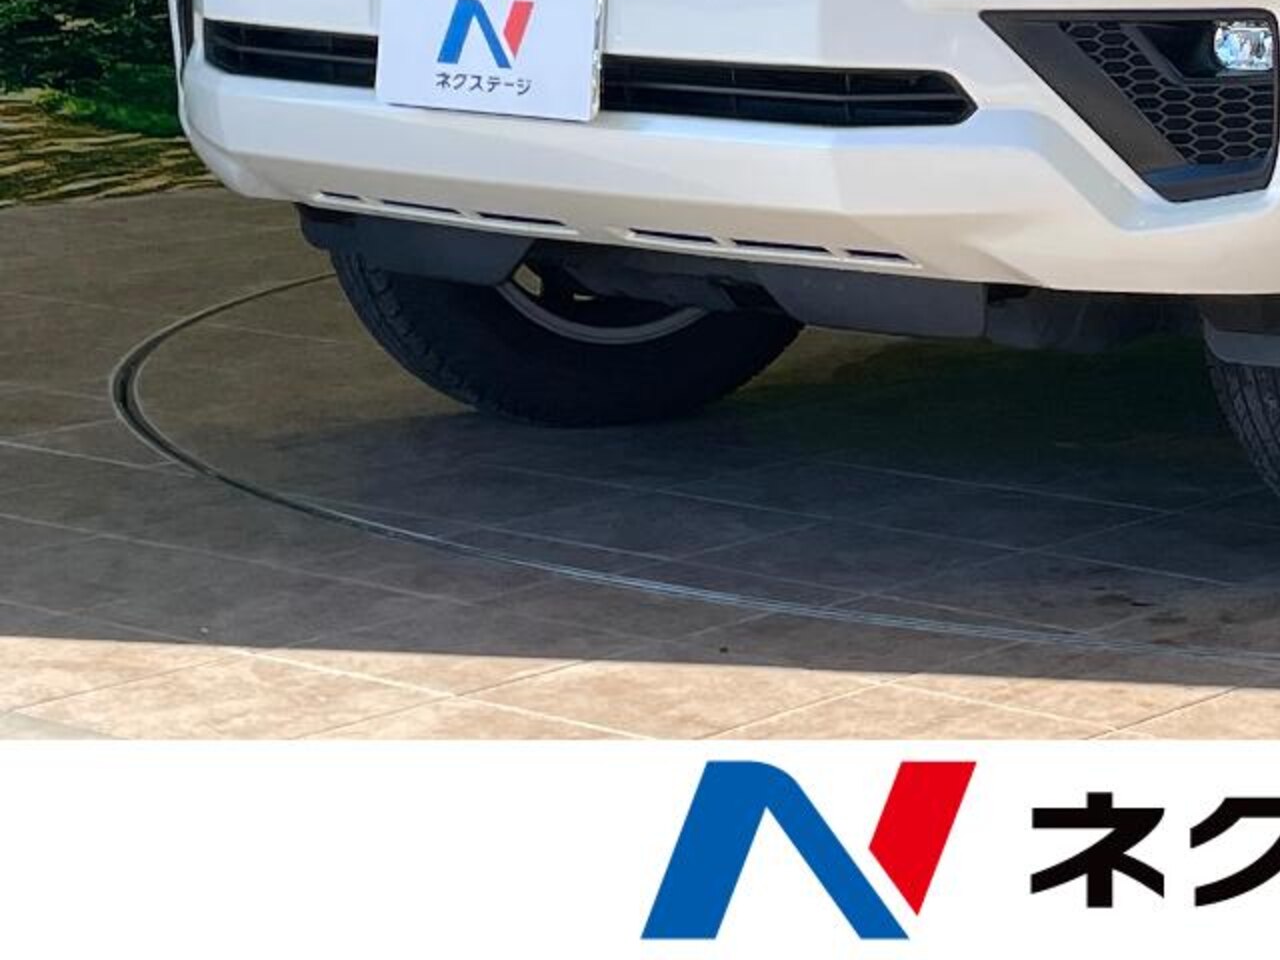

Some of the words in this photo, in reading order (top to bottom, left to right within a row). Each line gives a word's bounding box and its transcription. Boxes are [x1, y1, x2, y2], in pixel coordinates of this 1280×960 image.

[435, 71, 533, 96] ネクステージ
